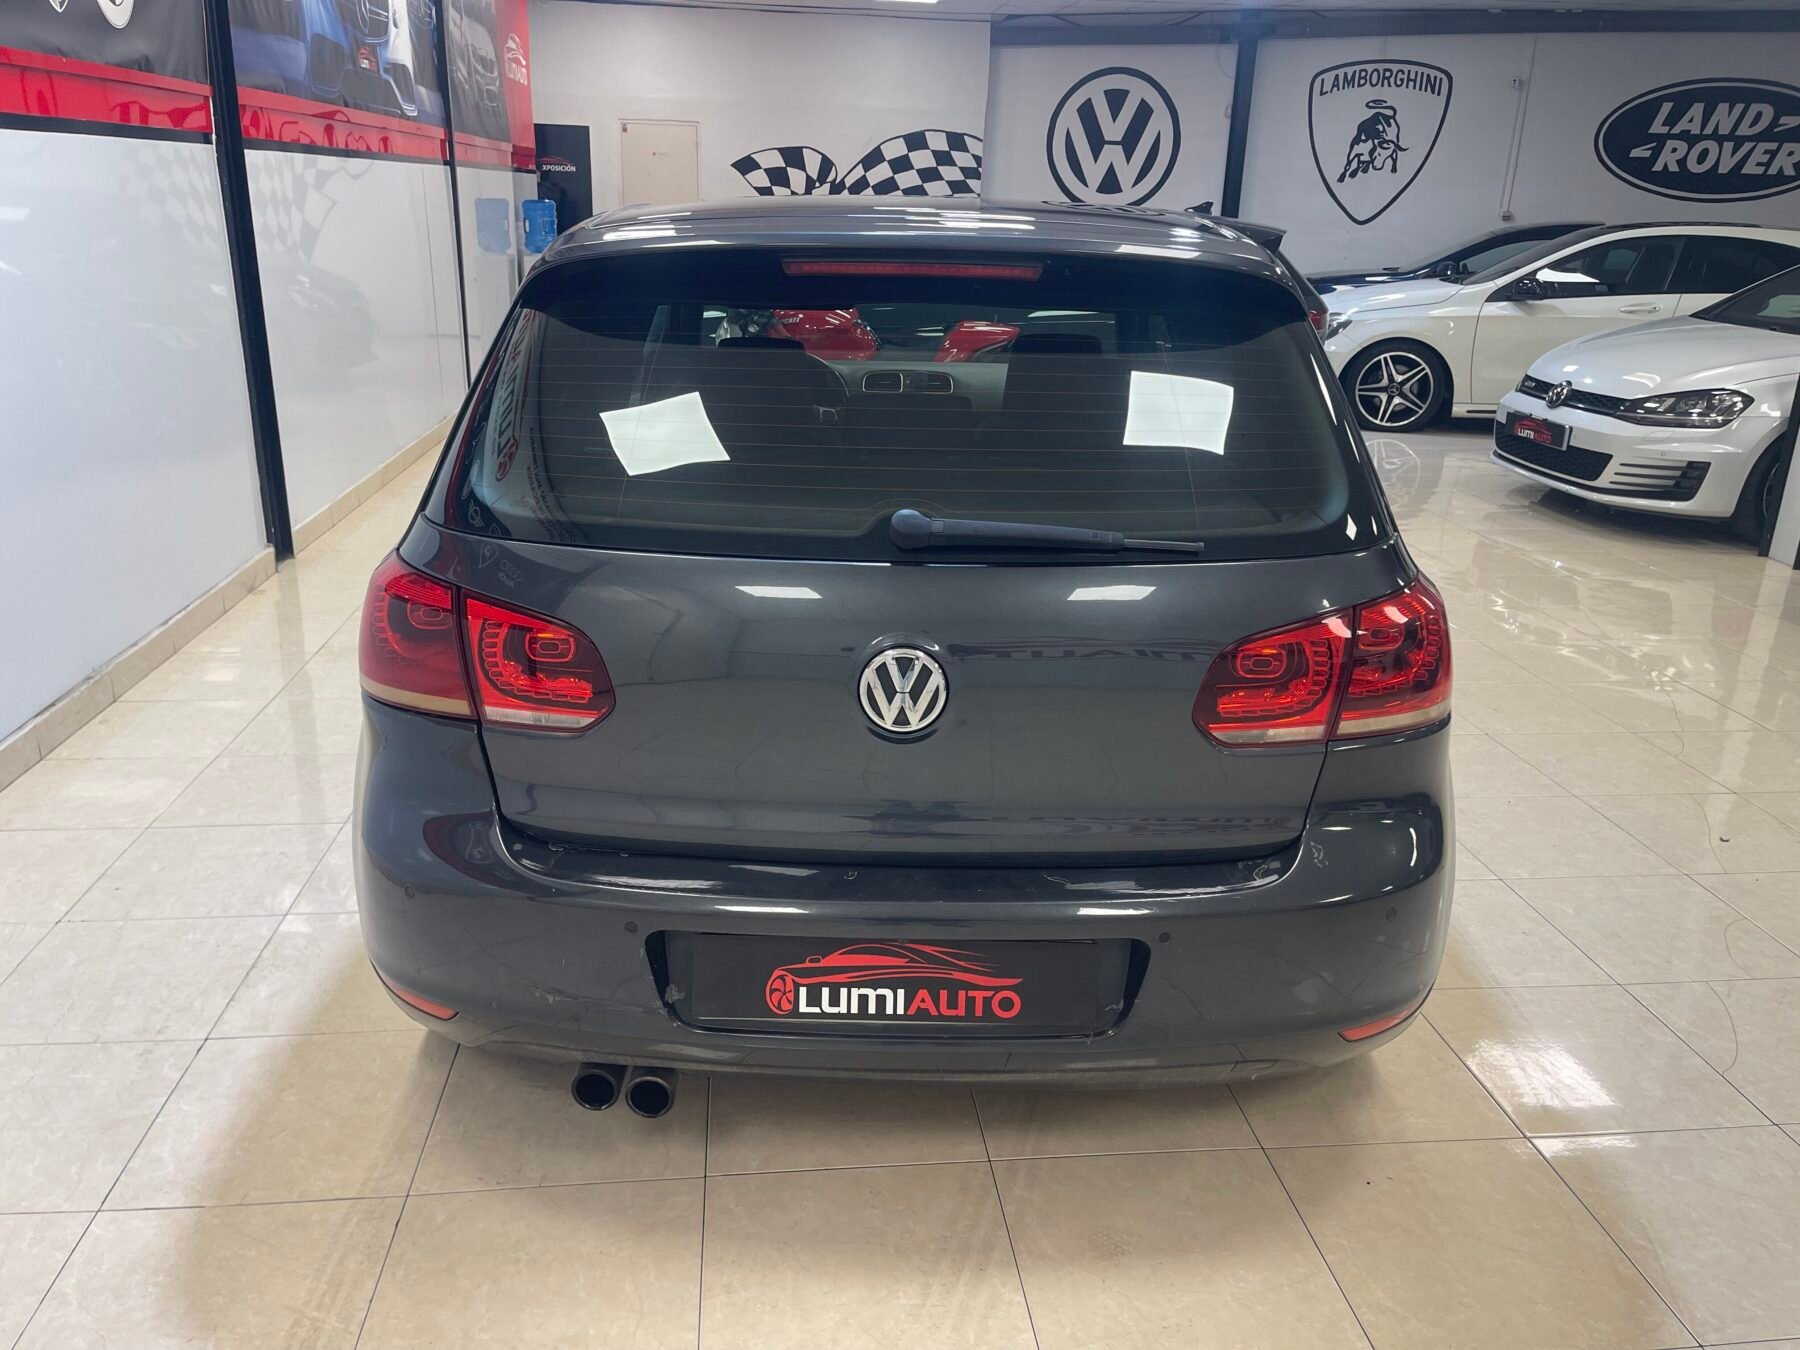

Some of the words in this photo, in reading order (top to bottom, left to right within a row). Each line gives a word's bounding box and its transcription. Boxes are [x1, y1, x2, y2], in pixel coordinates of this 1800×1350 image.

[1320, 68, 1443, 96] LAMBORGHINI
[1648, 102, 1774, 136] LAND
[542, 164, 576, 172] XPOSICIÓN
[1651, 139, 1800, 176] ROVER
